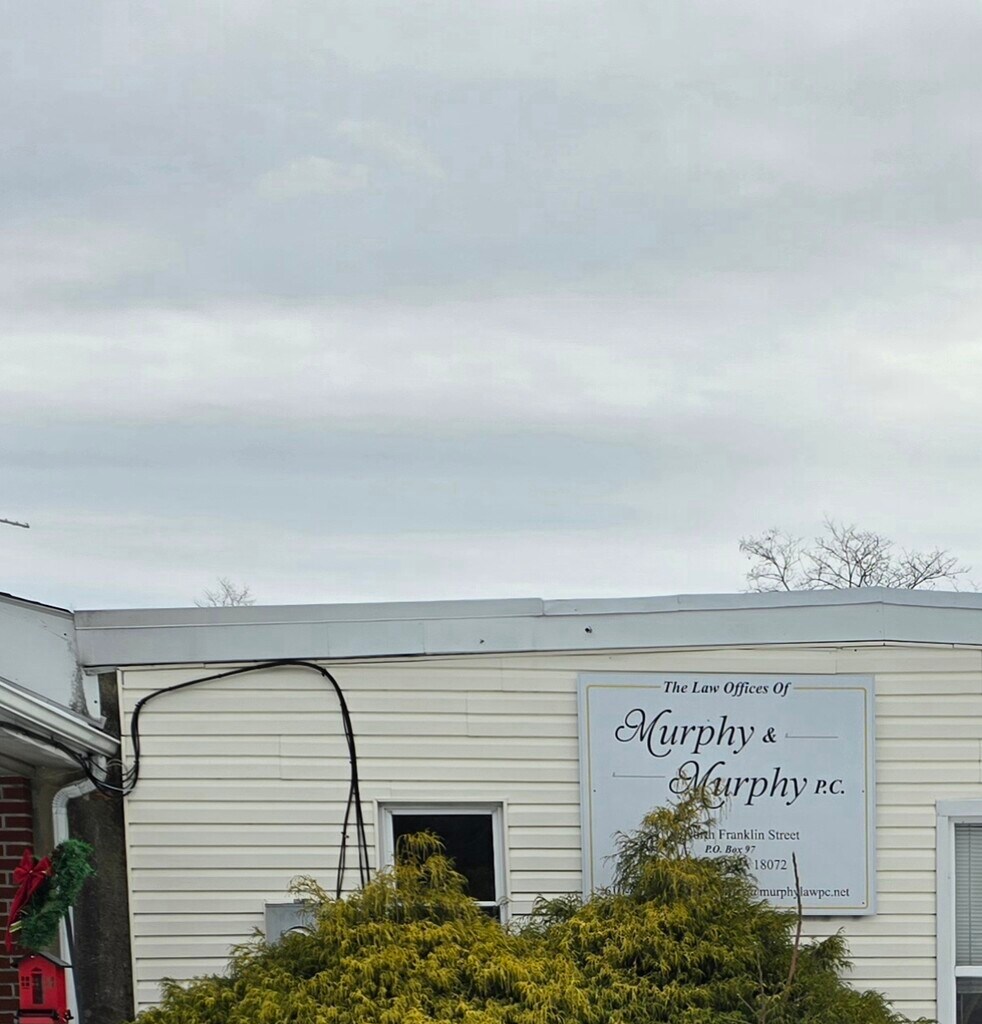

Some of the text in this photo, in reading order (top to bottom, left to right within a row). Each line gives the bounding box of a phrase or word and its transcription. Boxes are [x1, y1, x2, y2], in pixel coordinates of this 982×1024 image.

[664, 681, 792, 697] The Law Offices Of
[615, 708, 777, 758] Murphy &
[668, 760, 845, 810] Murphy P.C.
[718, 829, 765, 841] Franklin
[768, 829, 800, 841] Street
[704, 844, 756, 854] P.O. Box 97
[754, 859, 787, 870] 18072
